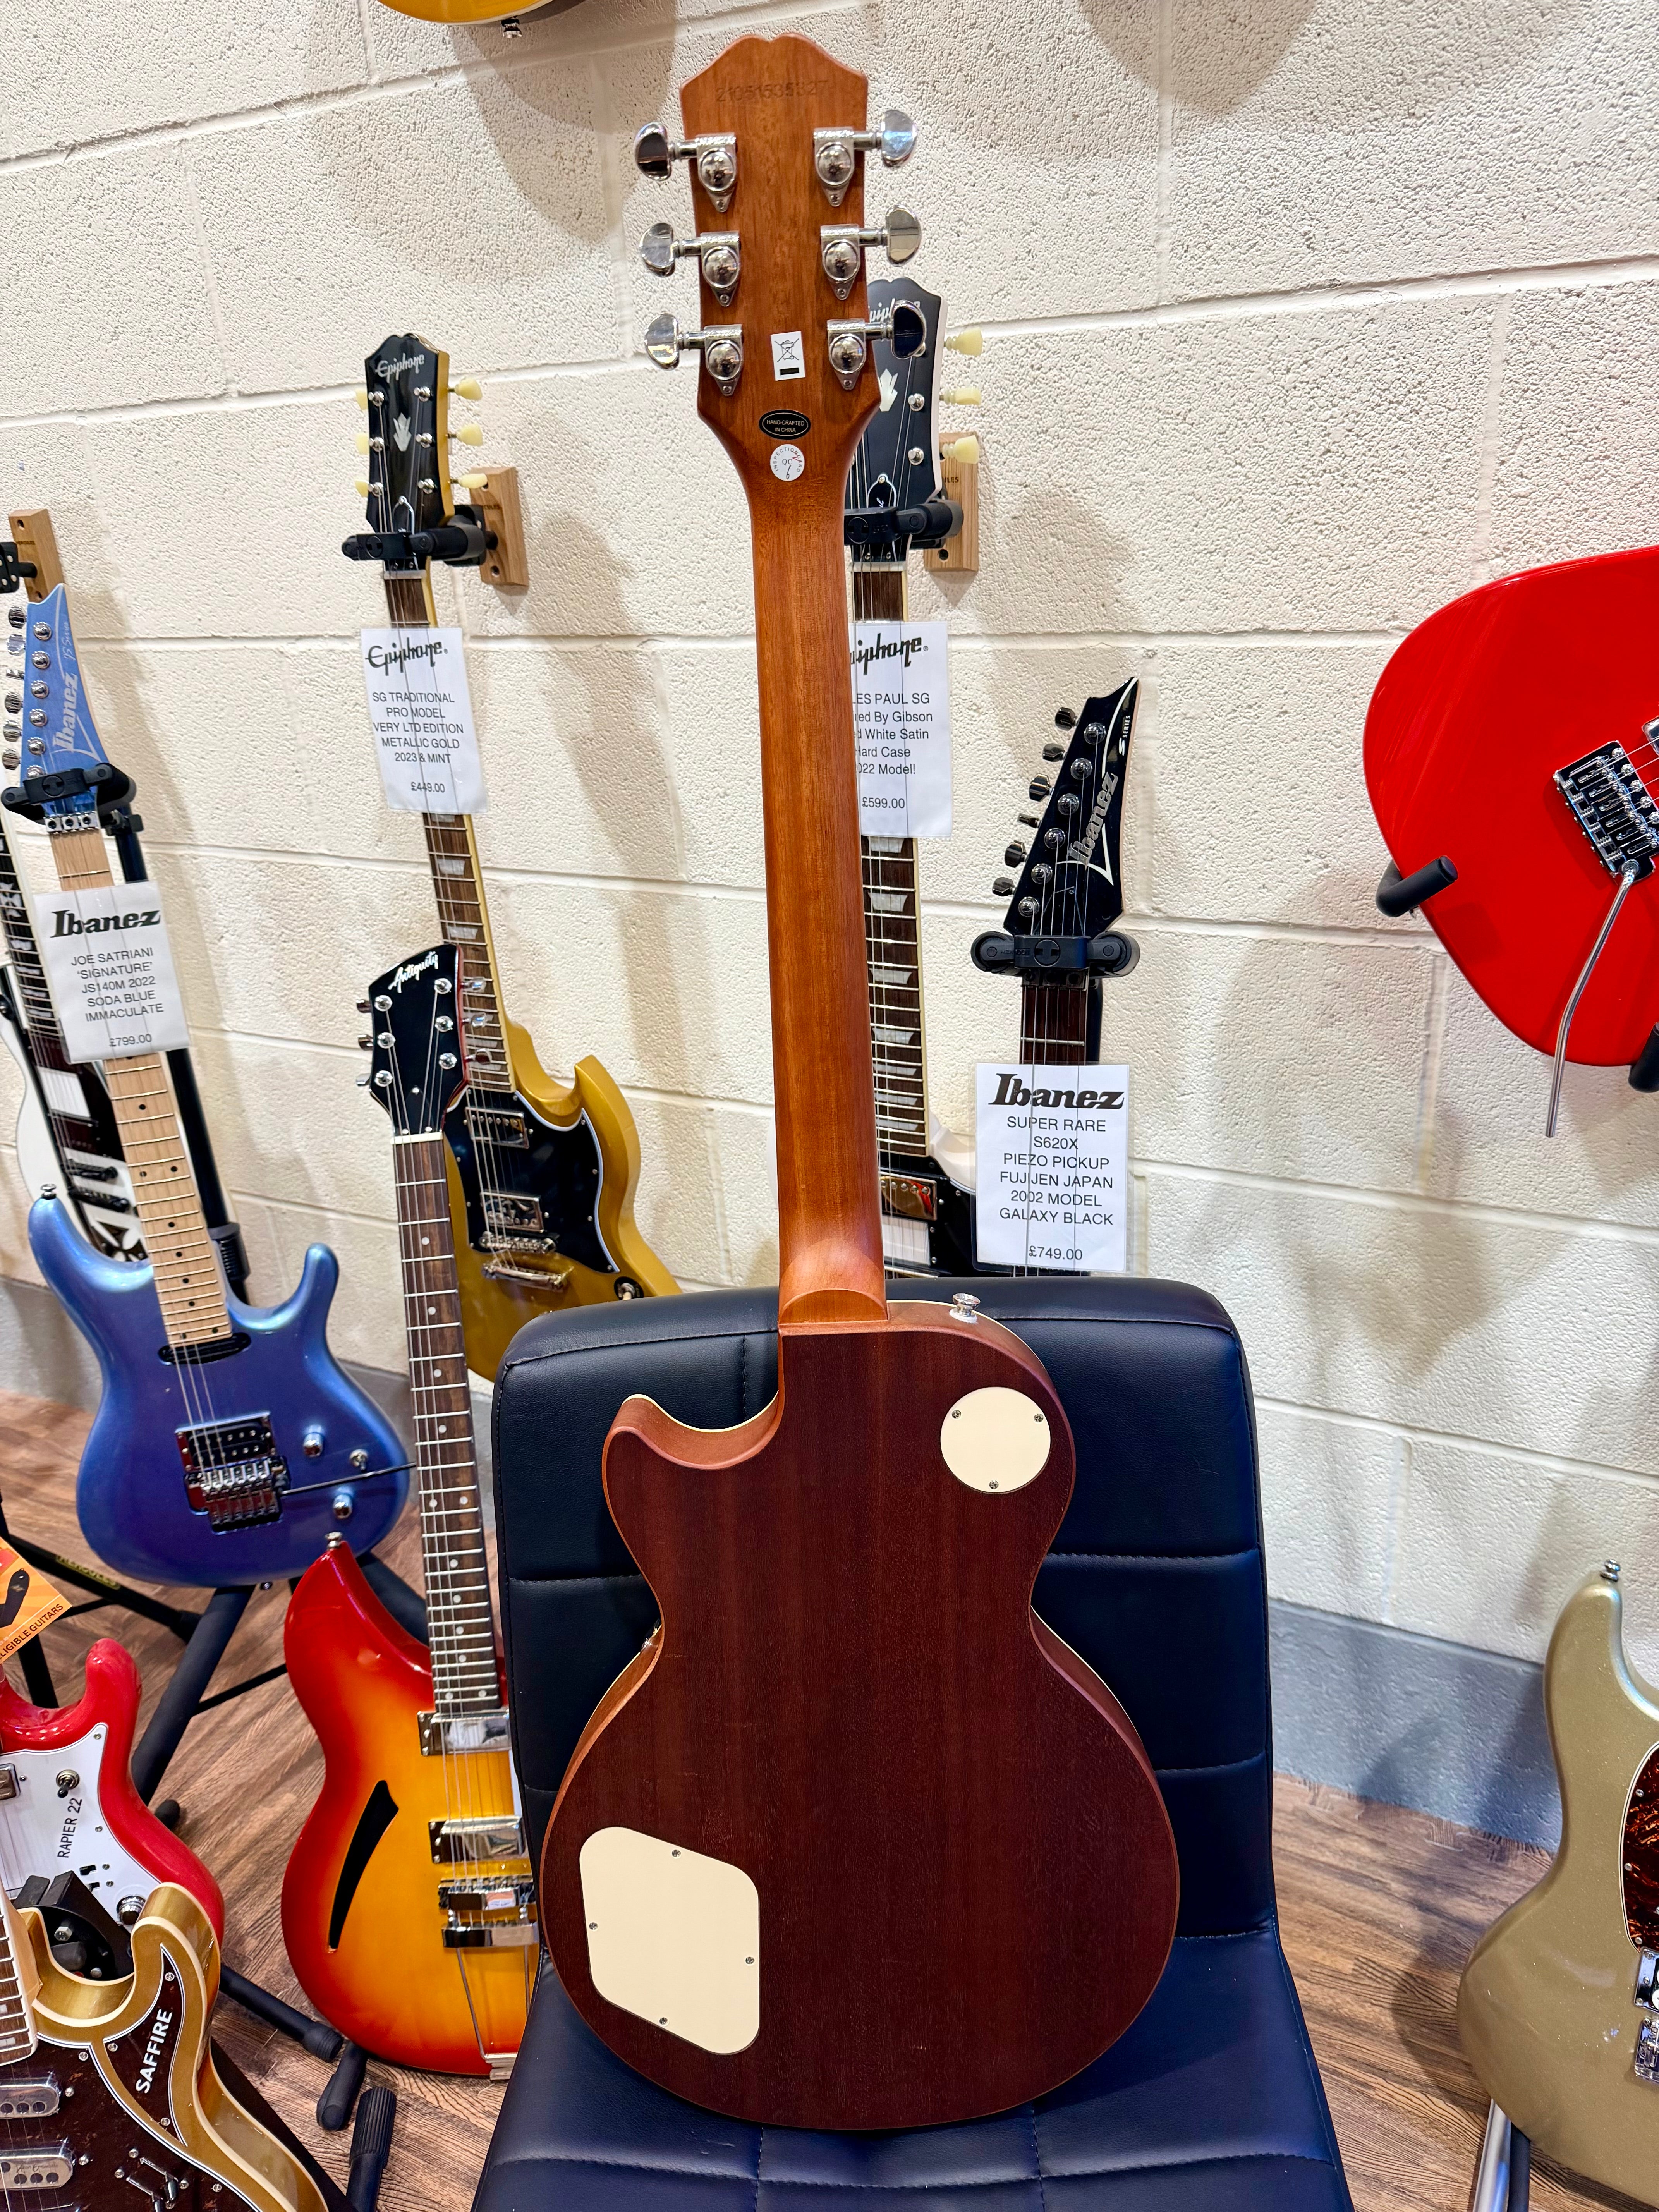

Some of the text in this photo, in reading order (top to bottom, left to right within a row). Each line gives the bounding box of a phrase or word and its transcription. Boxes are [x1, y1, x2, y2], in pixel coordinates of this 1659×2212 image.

[375, 353, 424, 383] Epiphone
[365, 637, 443, 676] Epiphone
[850, 633, 922, 675] iphone
[373, 692, 455, 703] SG TRADITIONAL
[875, 693, 908, 704] PAUL
[912, 693, 929, 704] SG
[53, 672, 77, 752] Ibanez
[386, 708, 446, 718] PRO MODEL
[875, 711, 888, 725] By
[892, 711, 933, 722] Gibson
[373, 722, 464, 733] VERY LTD EDITION
[865, 728, 896, 739] White
[900, 728, 929, 739] Satin
[1122, 715, 1130, 738] SERIES
[382, 737, 460, 749] METALLIC GOLD
[395, 753, 451, 763] 2023 & MINT
[881, 747, 910, 757] Case
[879, 764, 915, 774] Model!
[411, 782, 445, 793] £449.00
[862, 798, 905, 809] £599.00
[1066, 771, 1118, 870] Ibanez
[50, 910, 161, 938] Ibanez
[71, 947, 153, 966] JOE SATRIANI
[388, 951, 438, 993] Antiquity
[82, 976, 156, 994] JS140M 2022
[87, 990, 156, 1007] SODA BLUE
[86, 1003, 164, 1022] IMMACULATE
[109, 1034, 152, 1047] £799.00
[988, 1073, 1125, 1109] Ibanez
[1007, 1116, 1106, 1132] SUPER RARE
[1033, 1136, 1078, 1149] S620X
[1004, 1153, 1109, 1169] PIEZO PICKUP
[1000, 1171, 1113, 1188] FUJJEN JAPAN
[1010, 1190, 1102, 1206] 2002 MODEL
[1000, 1208, 1113, 1225] GALAXY BLACK
[1029, 1246, 1082, 1260] £749.00
[29, 1604, 63, 1632] GUITARS
[57, 1798, 82, 1858] RAPIER 22
[135, 2008, 172, 2094] SAFFIRE
